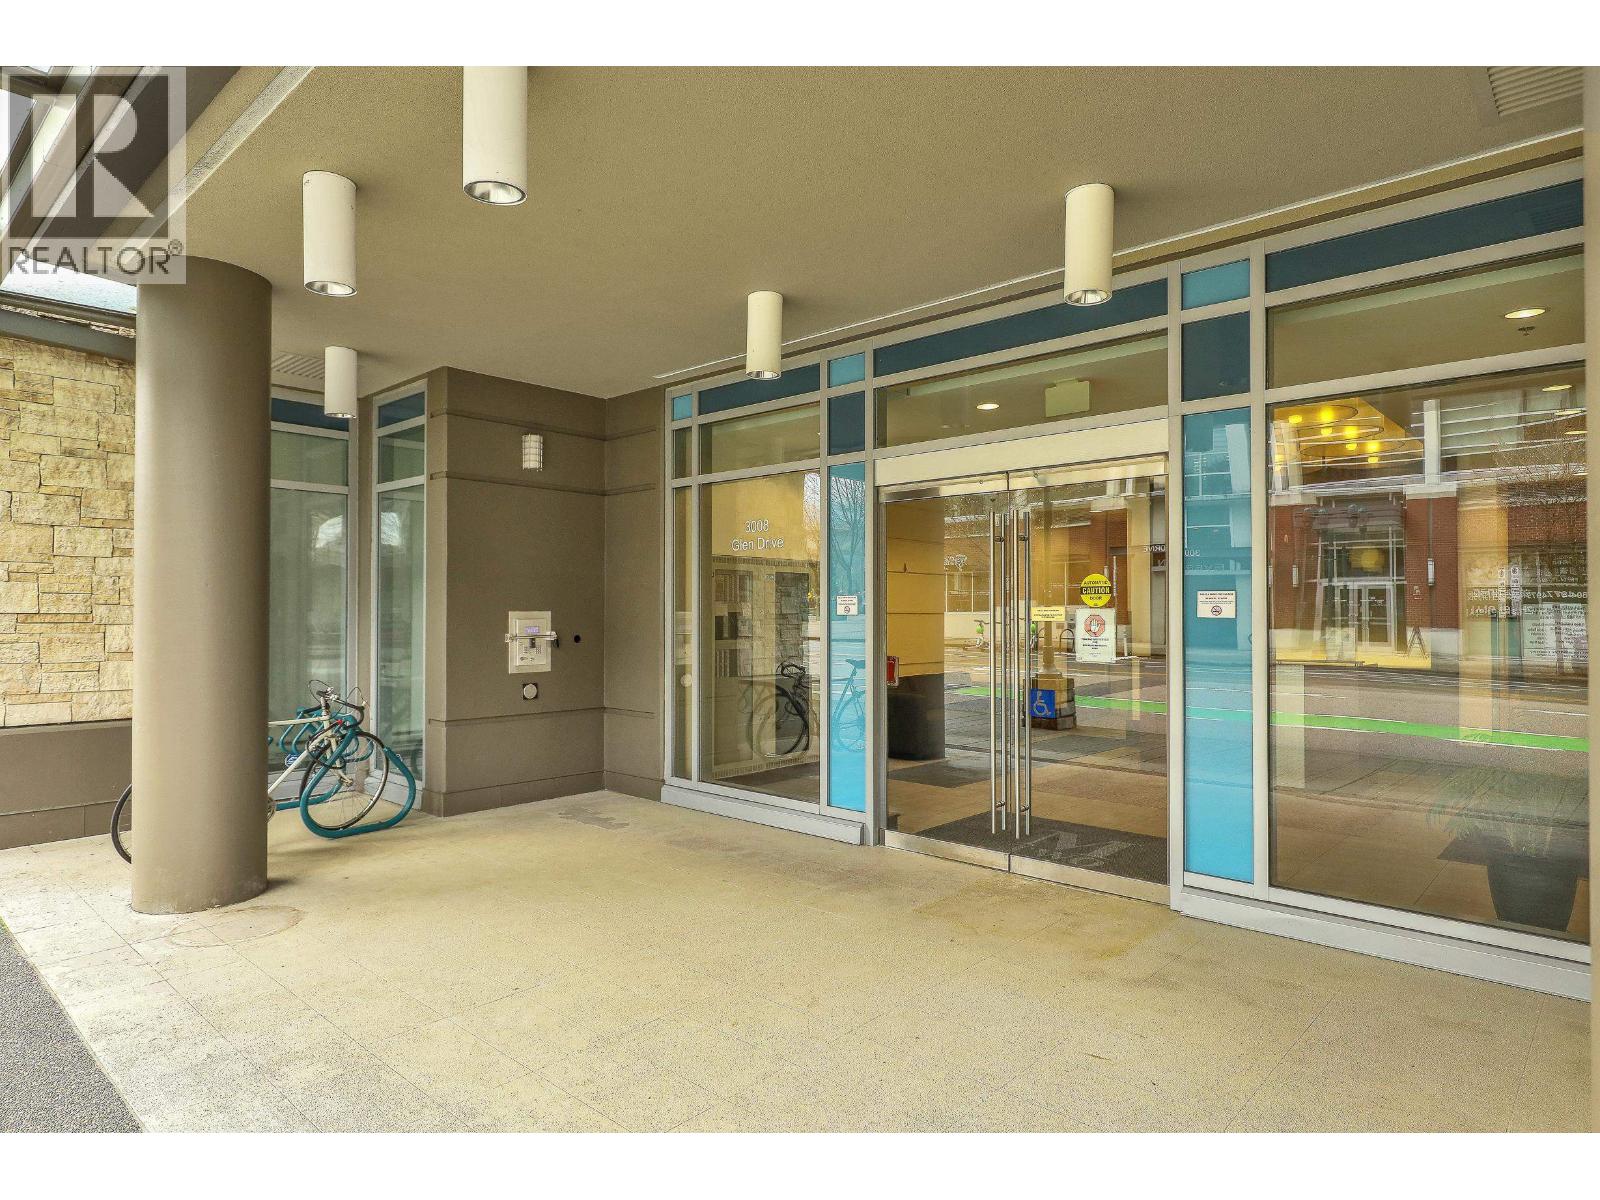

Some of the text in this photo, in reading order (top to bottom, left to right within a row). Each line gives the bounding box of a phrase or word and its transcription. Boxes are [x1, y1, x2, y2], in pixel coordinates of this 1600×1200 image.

[745, 519, 769, 533] 3008
[731, 537, 784, 551] Glen Drive
[1082, 586, 1110, 595] CAUTION
